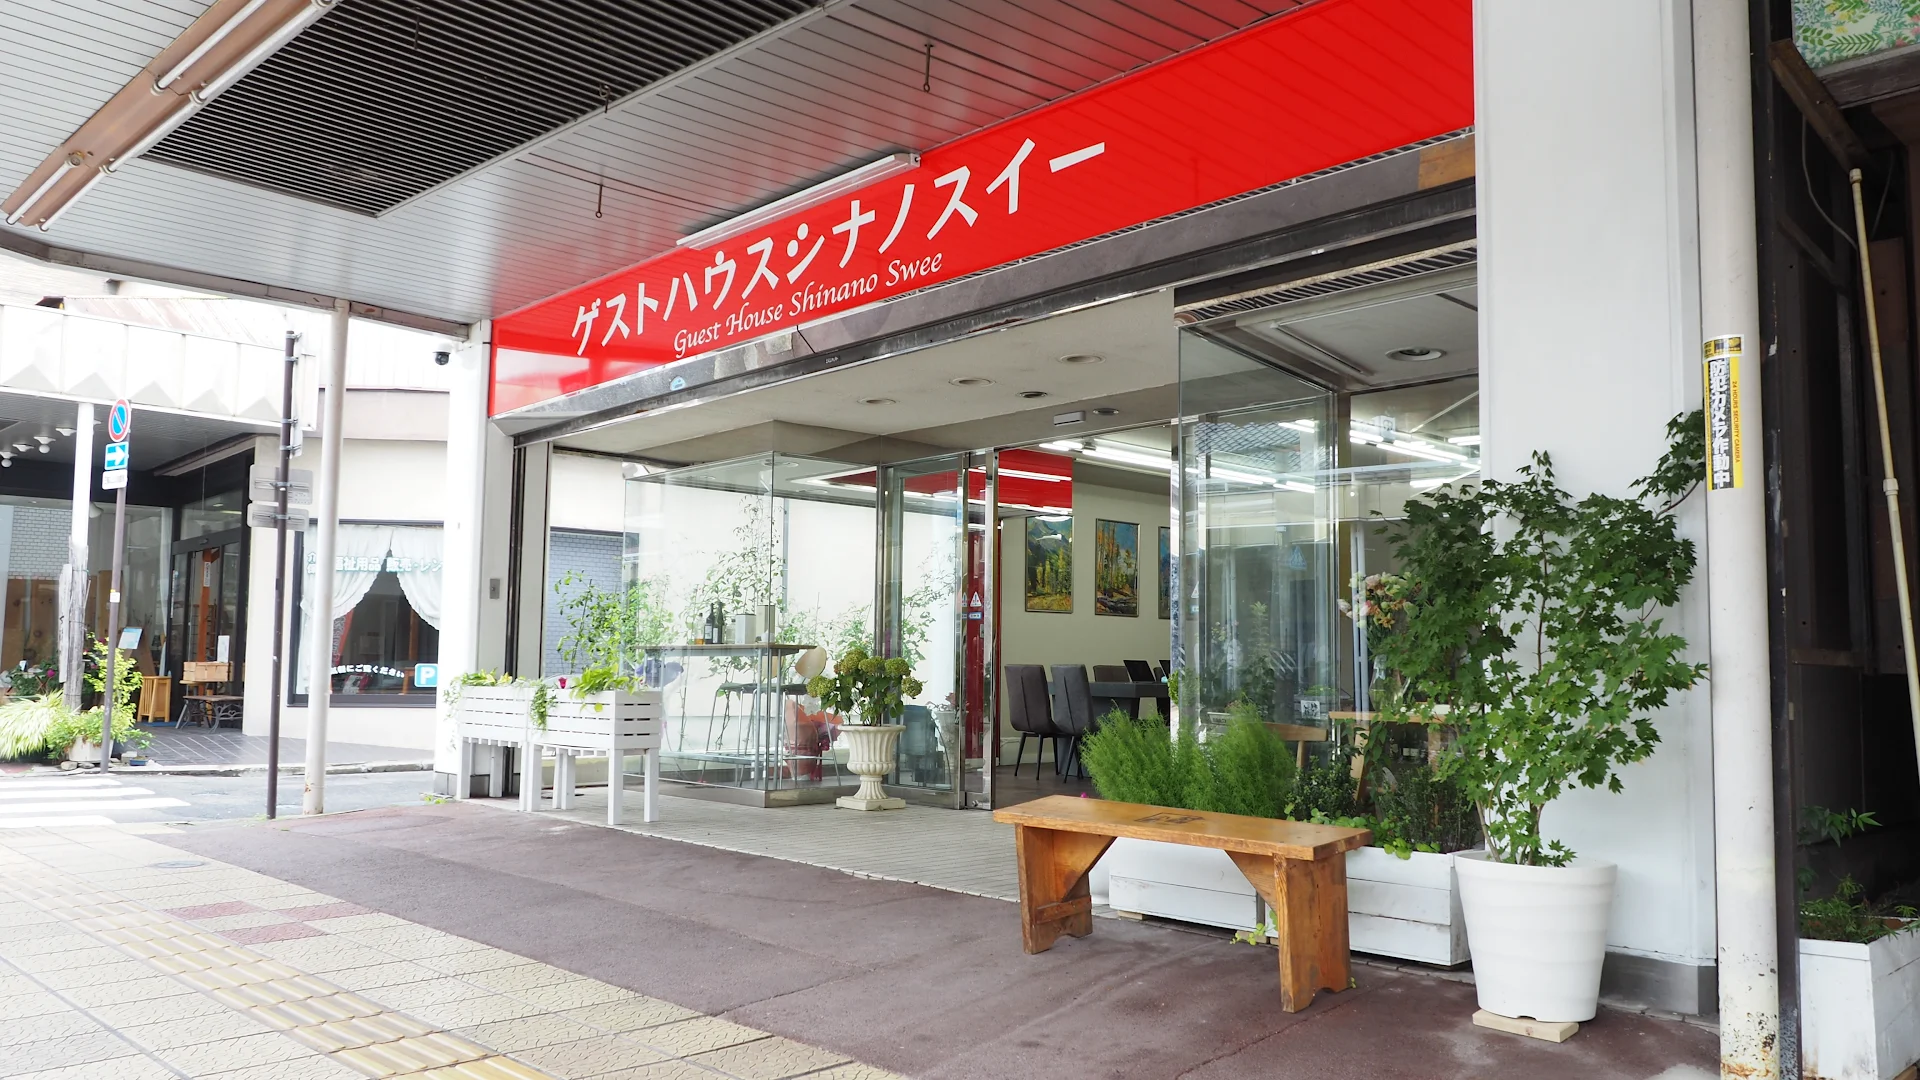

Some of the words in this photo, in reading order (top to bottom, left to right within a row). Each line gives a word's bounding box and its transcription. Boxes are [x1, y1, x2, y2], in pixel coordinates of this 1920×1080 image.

[571, 138, 1106, 356] ゲストハウスシナノスイー
[673, 322, 722, 359] Guest
[725, 302, 784, 337] House
[788, 273, 879, 317] Shinano
[885, 252, 943, 288] Swee
[1710, 360, 1730, 487] 防犯カメラ作動中
[1732, 380, 1738, 389] 24
[420, 666, 436, 685] P
